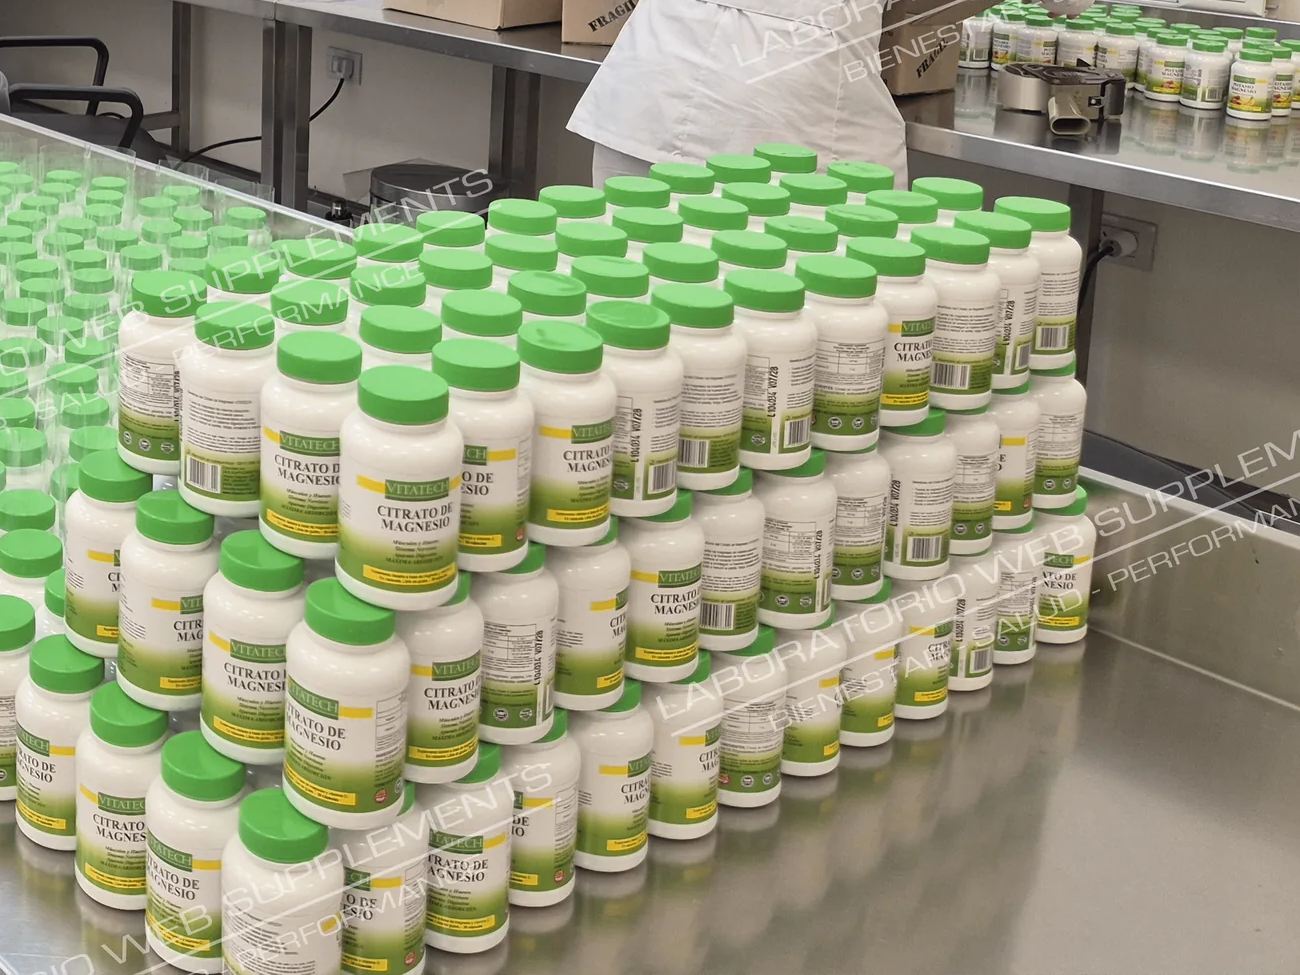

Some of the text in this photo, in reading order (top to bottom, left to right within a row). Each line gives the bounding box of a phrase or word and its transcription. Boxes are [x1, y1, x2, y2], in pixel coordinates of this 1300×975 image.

[1003, 300, 1015, 345] L104034 V07/28
[767, 366, 779, 418] L104034 V07/28
[631, 408, 643, 462] L104034 V07/28
[274, 454, 324, 474] CITRATO
[476, 472, 494, 484] DE
[386, 481, 449, 496] VITATECH
[377, 502, 453, 520] CITRATO DE
[381, 516, 450, 533] MAGNESIO
[1065, 573, 1076, 581] DE
[651, 589, 696, 604] CITRATO
[224, 662, 280, 680] CITRATO
[424, 680, 475, 699] CITRATO
[328, 726, 346, 740] DE
[41, 763, 56, 773] DE
[93, 813, 145, 831] CITRATO
[473, 859, 488, 871] DE
[182, 878, 200, 891] DE
[360, 897, 377, 909] DE
